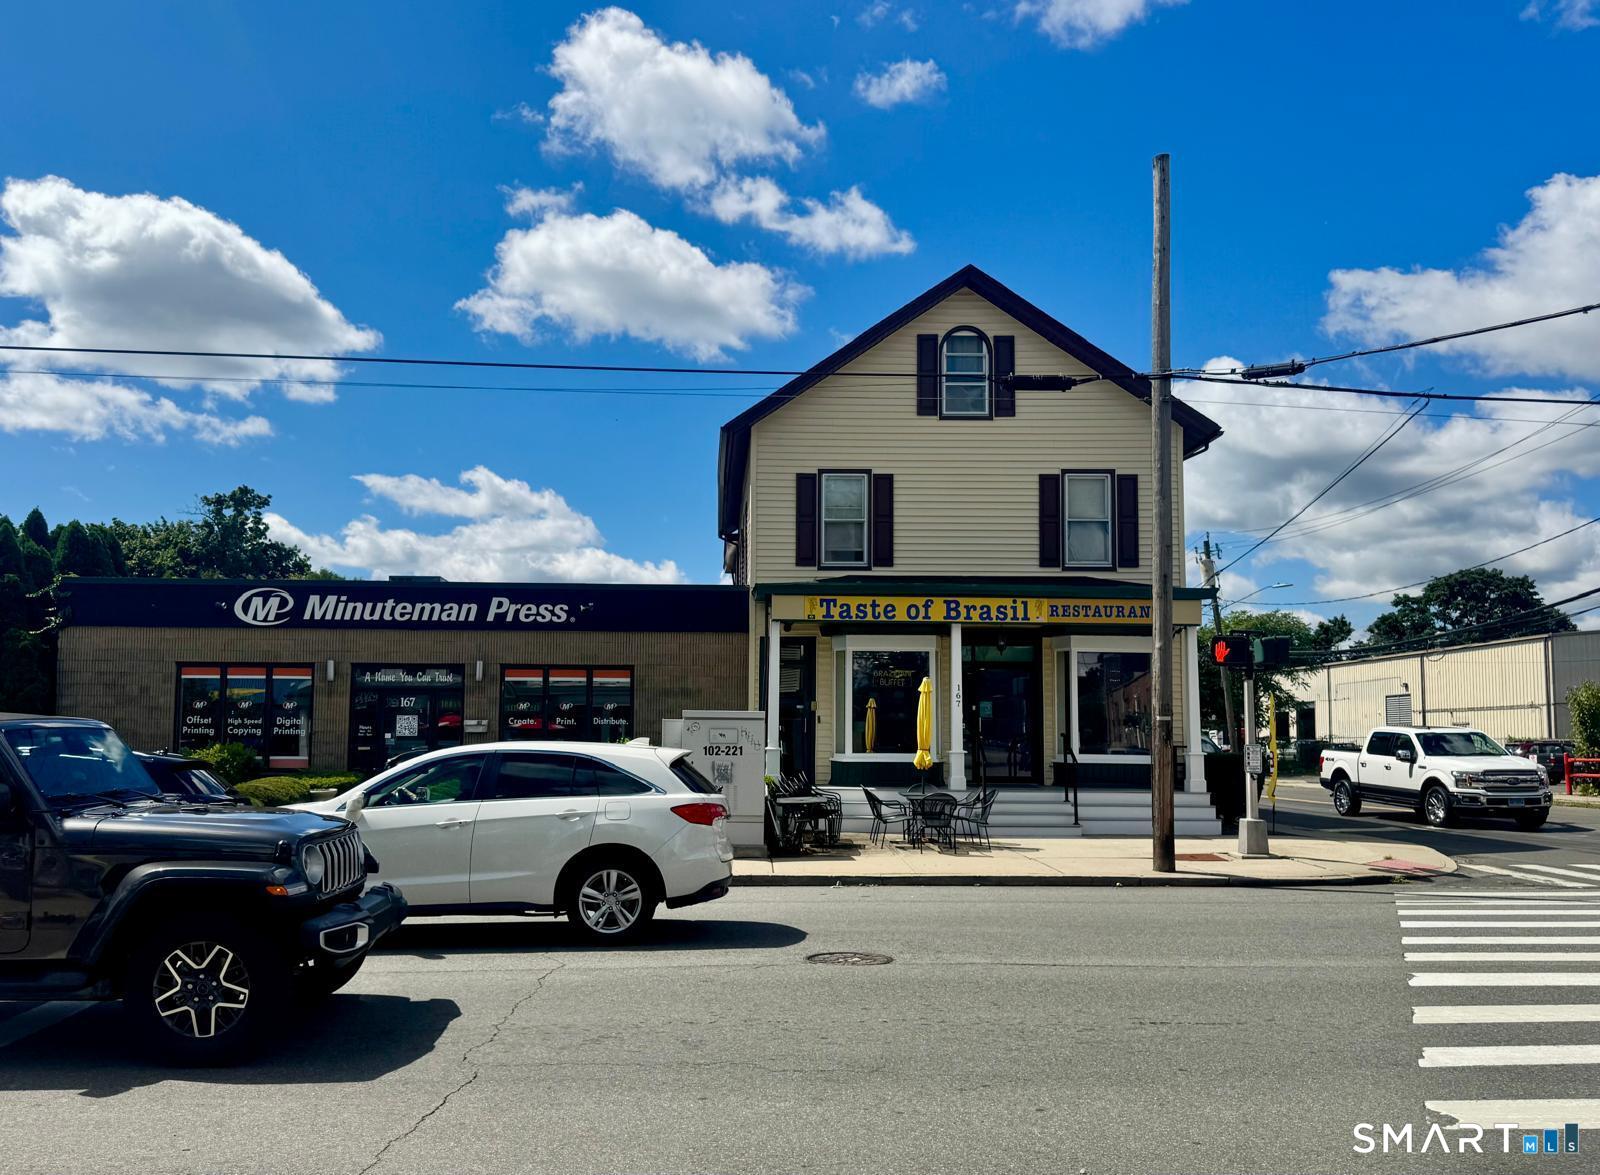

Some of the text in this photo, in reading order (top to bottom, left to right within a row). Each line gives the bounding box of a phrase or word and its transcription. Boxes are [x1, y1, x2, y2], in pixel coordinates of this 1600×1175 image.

[303, 594, 478, 622] Minuteman
[819, 598, 1031, 621] Taste of Brasil
[1049, 604, 1151, 618] RESTAURAN
[364, 672, 371, 682] A
[400, 672, 413, 682] You
[416, 672, 431, 682] Can
[400, 697, 416, 707] 167
[186, 716, 212, 724] Offset
[228, 717, 262, 725] High Speed
[276, 716, 304, 726] Digital
[508, 717, 537, 725] Create.
[556, 717, 576, 725] Print.
[593, 717, 629, 725] Distribute.
[182, 726, 215, 736] Printing
[227, 726, 262, 736] Copying
[273, 727, 306, 736] Printing
[703, 745, 743, 756] 102-221
